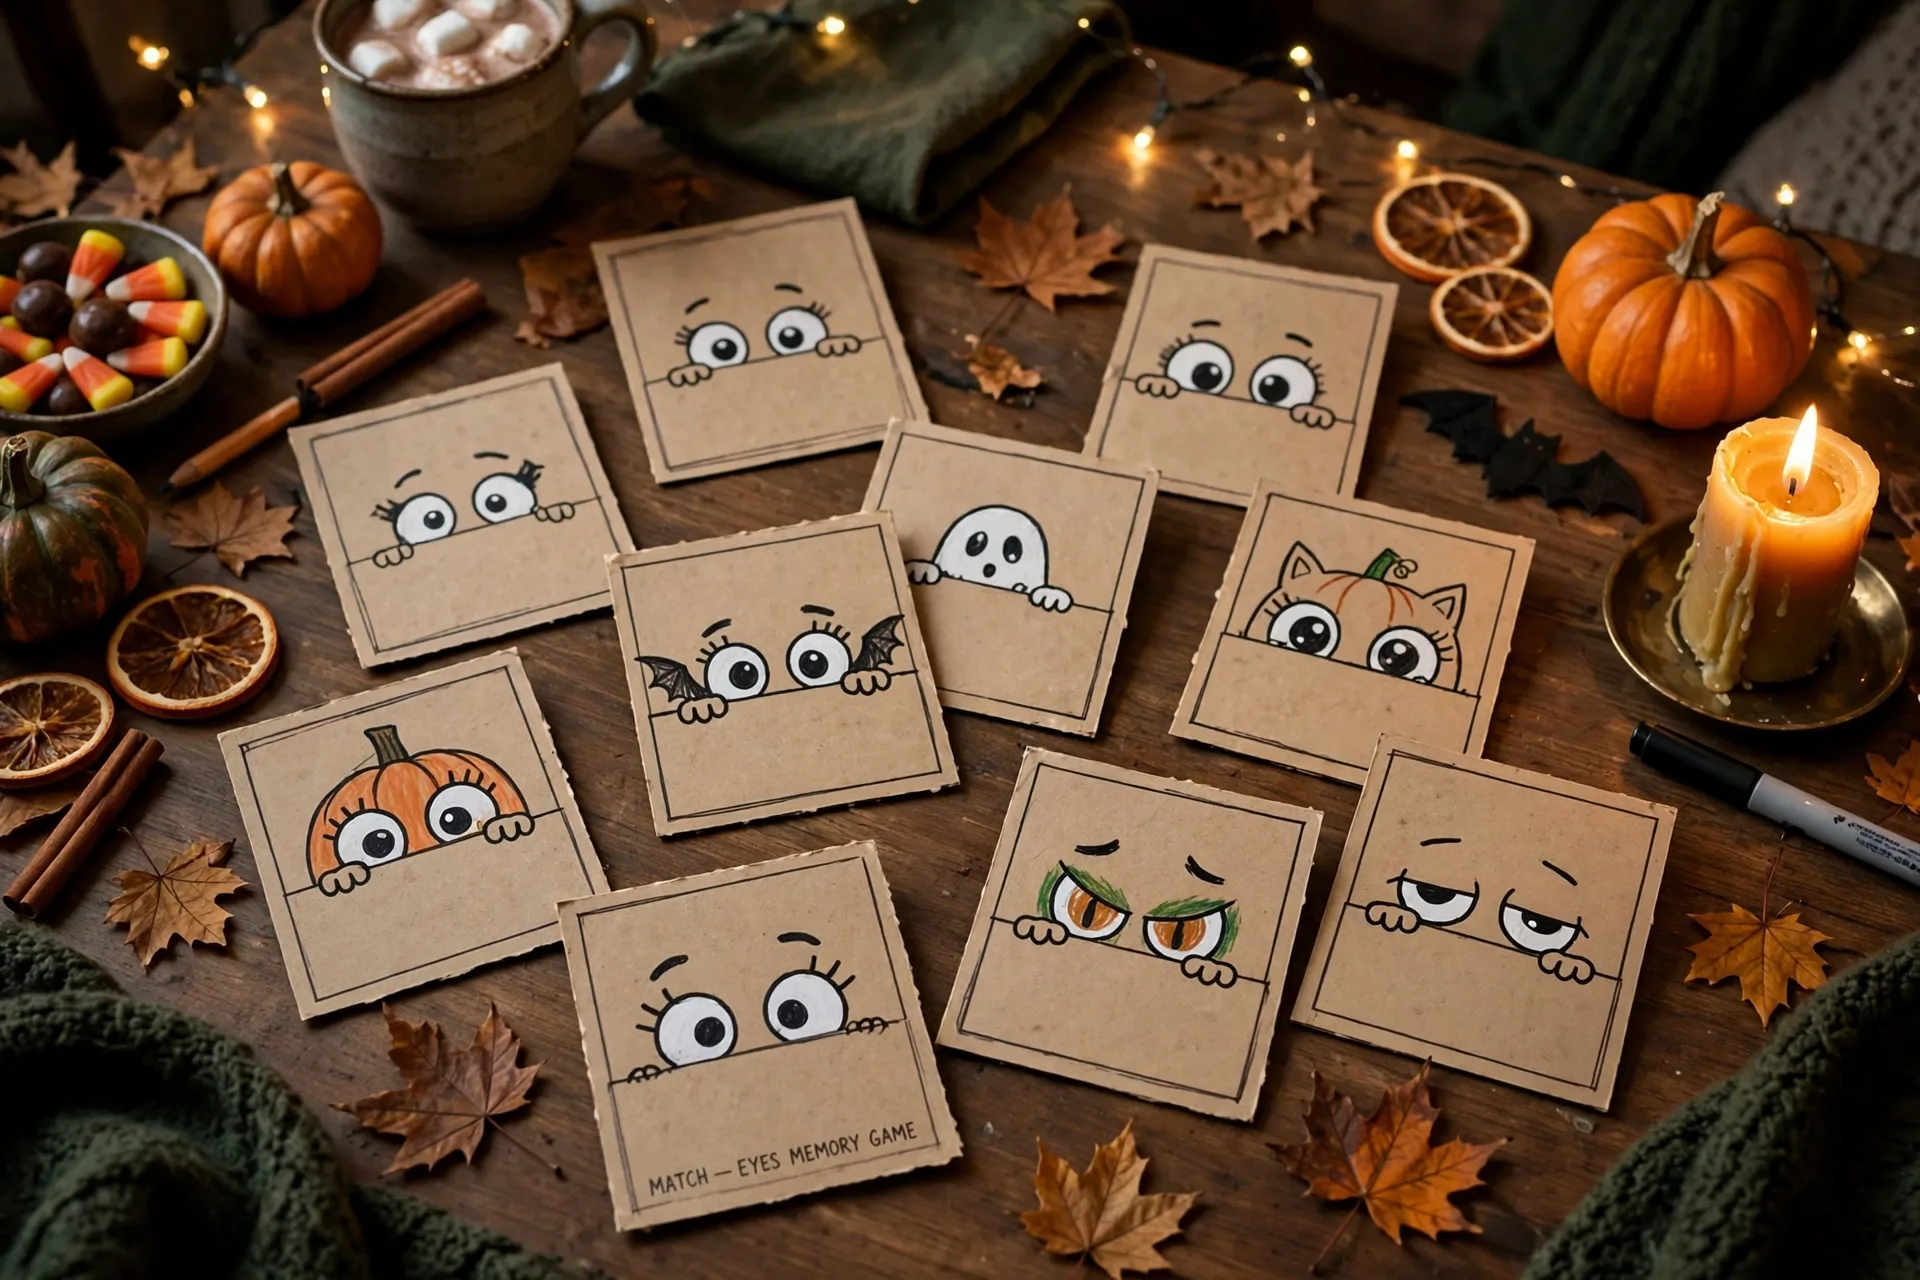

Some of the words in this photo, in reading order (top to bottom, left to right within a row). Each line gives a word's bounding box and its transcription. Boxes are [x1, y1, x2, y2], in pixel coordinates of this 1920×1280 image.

[648, 1167, 709, 1196] MATCH
[737, 1152, 781, 1177] EYES
[789, 1133, 860, 1166] MEMORY
[868, 1121, 918, 1147] GAME
